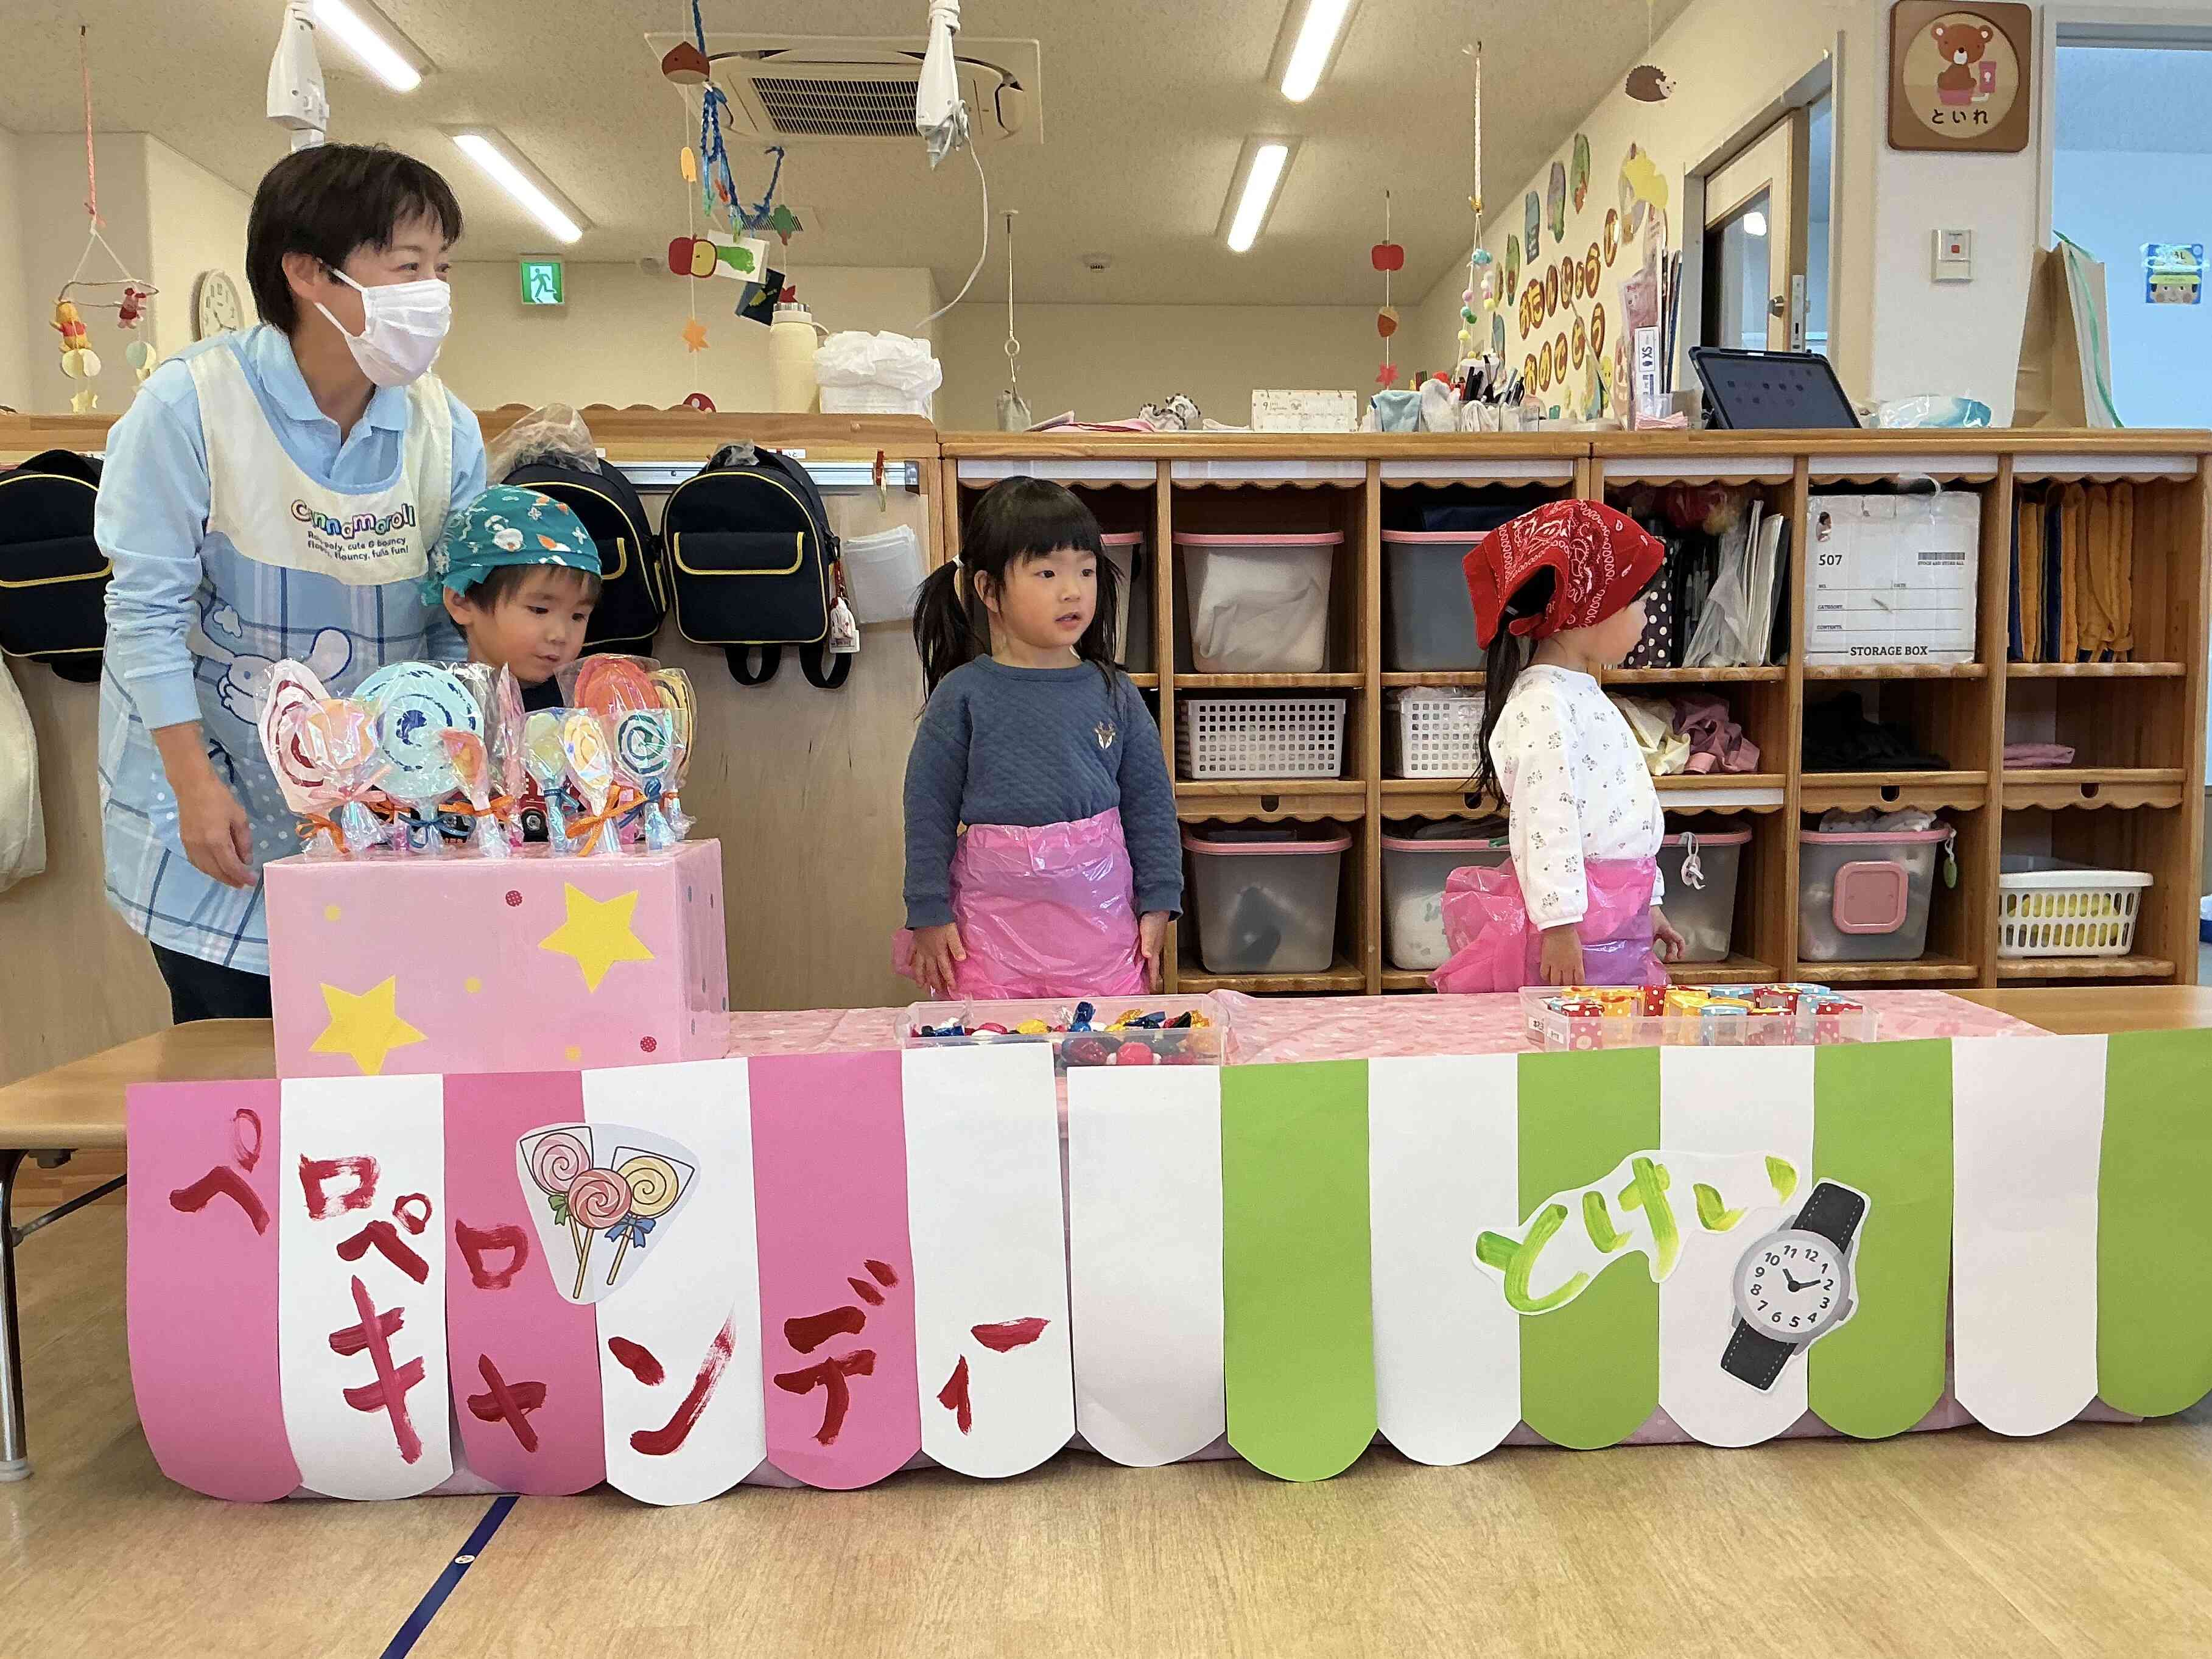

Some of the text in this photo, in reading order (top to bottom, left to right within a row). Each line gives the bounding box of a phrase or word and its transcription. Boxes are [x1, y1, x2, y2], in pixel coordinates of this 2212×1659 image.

[1931, 108, 1989, 125] といれ
[1818, 555, 1842, 566] 507
[1850, 645, 1928, 656] STORAGE BOX
[1476, 1156, 1797, 1312] とけい
[1783, 1244, 1797, 1259] 11
[1805, 1248, 1819, 1262] 12
[1764, 1252, 1780, 1266] 10
[1755, 1266, 1766, 1278] 9
[1821, 1263, 1828, 1274] 1
[1750, 1283, 1762, 1296] 8
[1822, 1279, 1834, 1291] 2
[1757, 1300, 1768, 1311] 7
[1819, 1297, 1831, 1309] 3
[1771, 1311, 1782, 1322] 6
[1788, 1316, 1800, 1327] 5
[1807, 1312, 1817, 1324] 4
